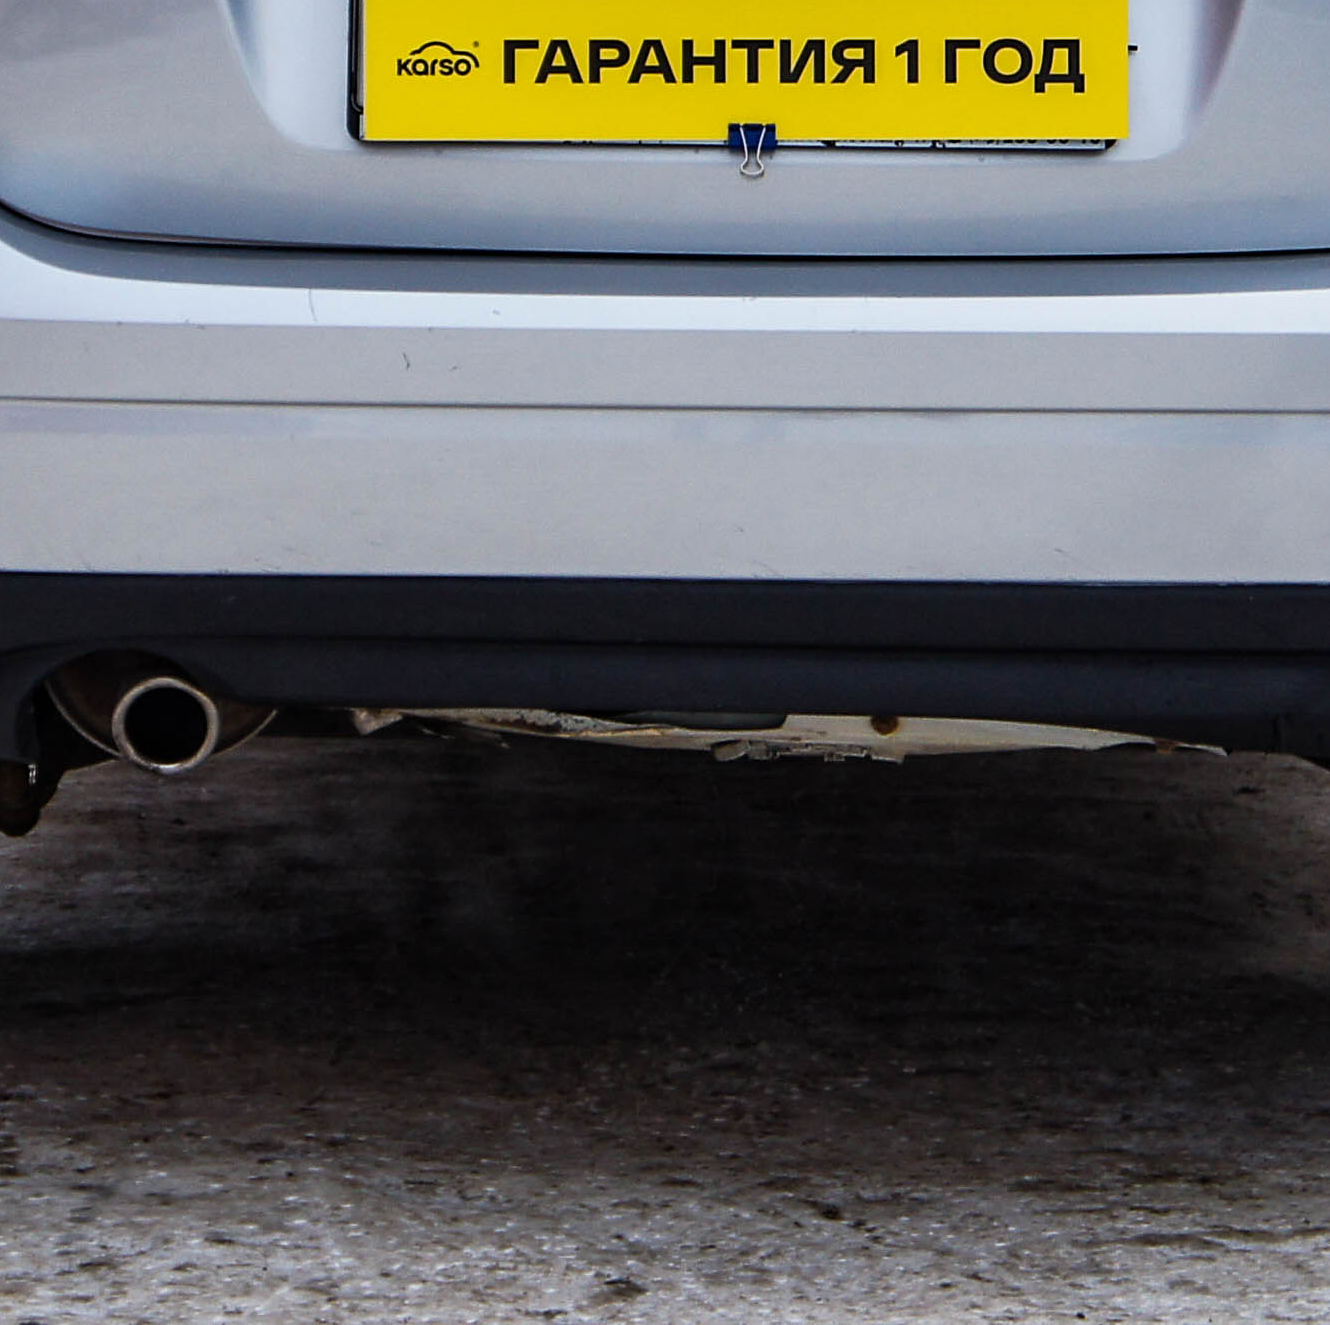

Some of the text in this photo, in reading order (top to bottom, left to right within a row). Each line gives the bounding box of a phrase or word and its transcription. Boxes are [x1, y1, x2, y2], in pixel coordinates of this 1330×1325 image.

[503, 38, 1086, 94] ГАРАНТИЯ 1 ГОД
